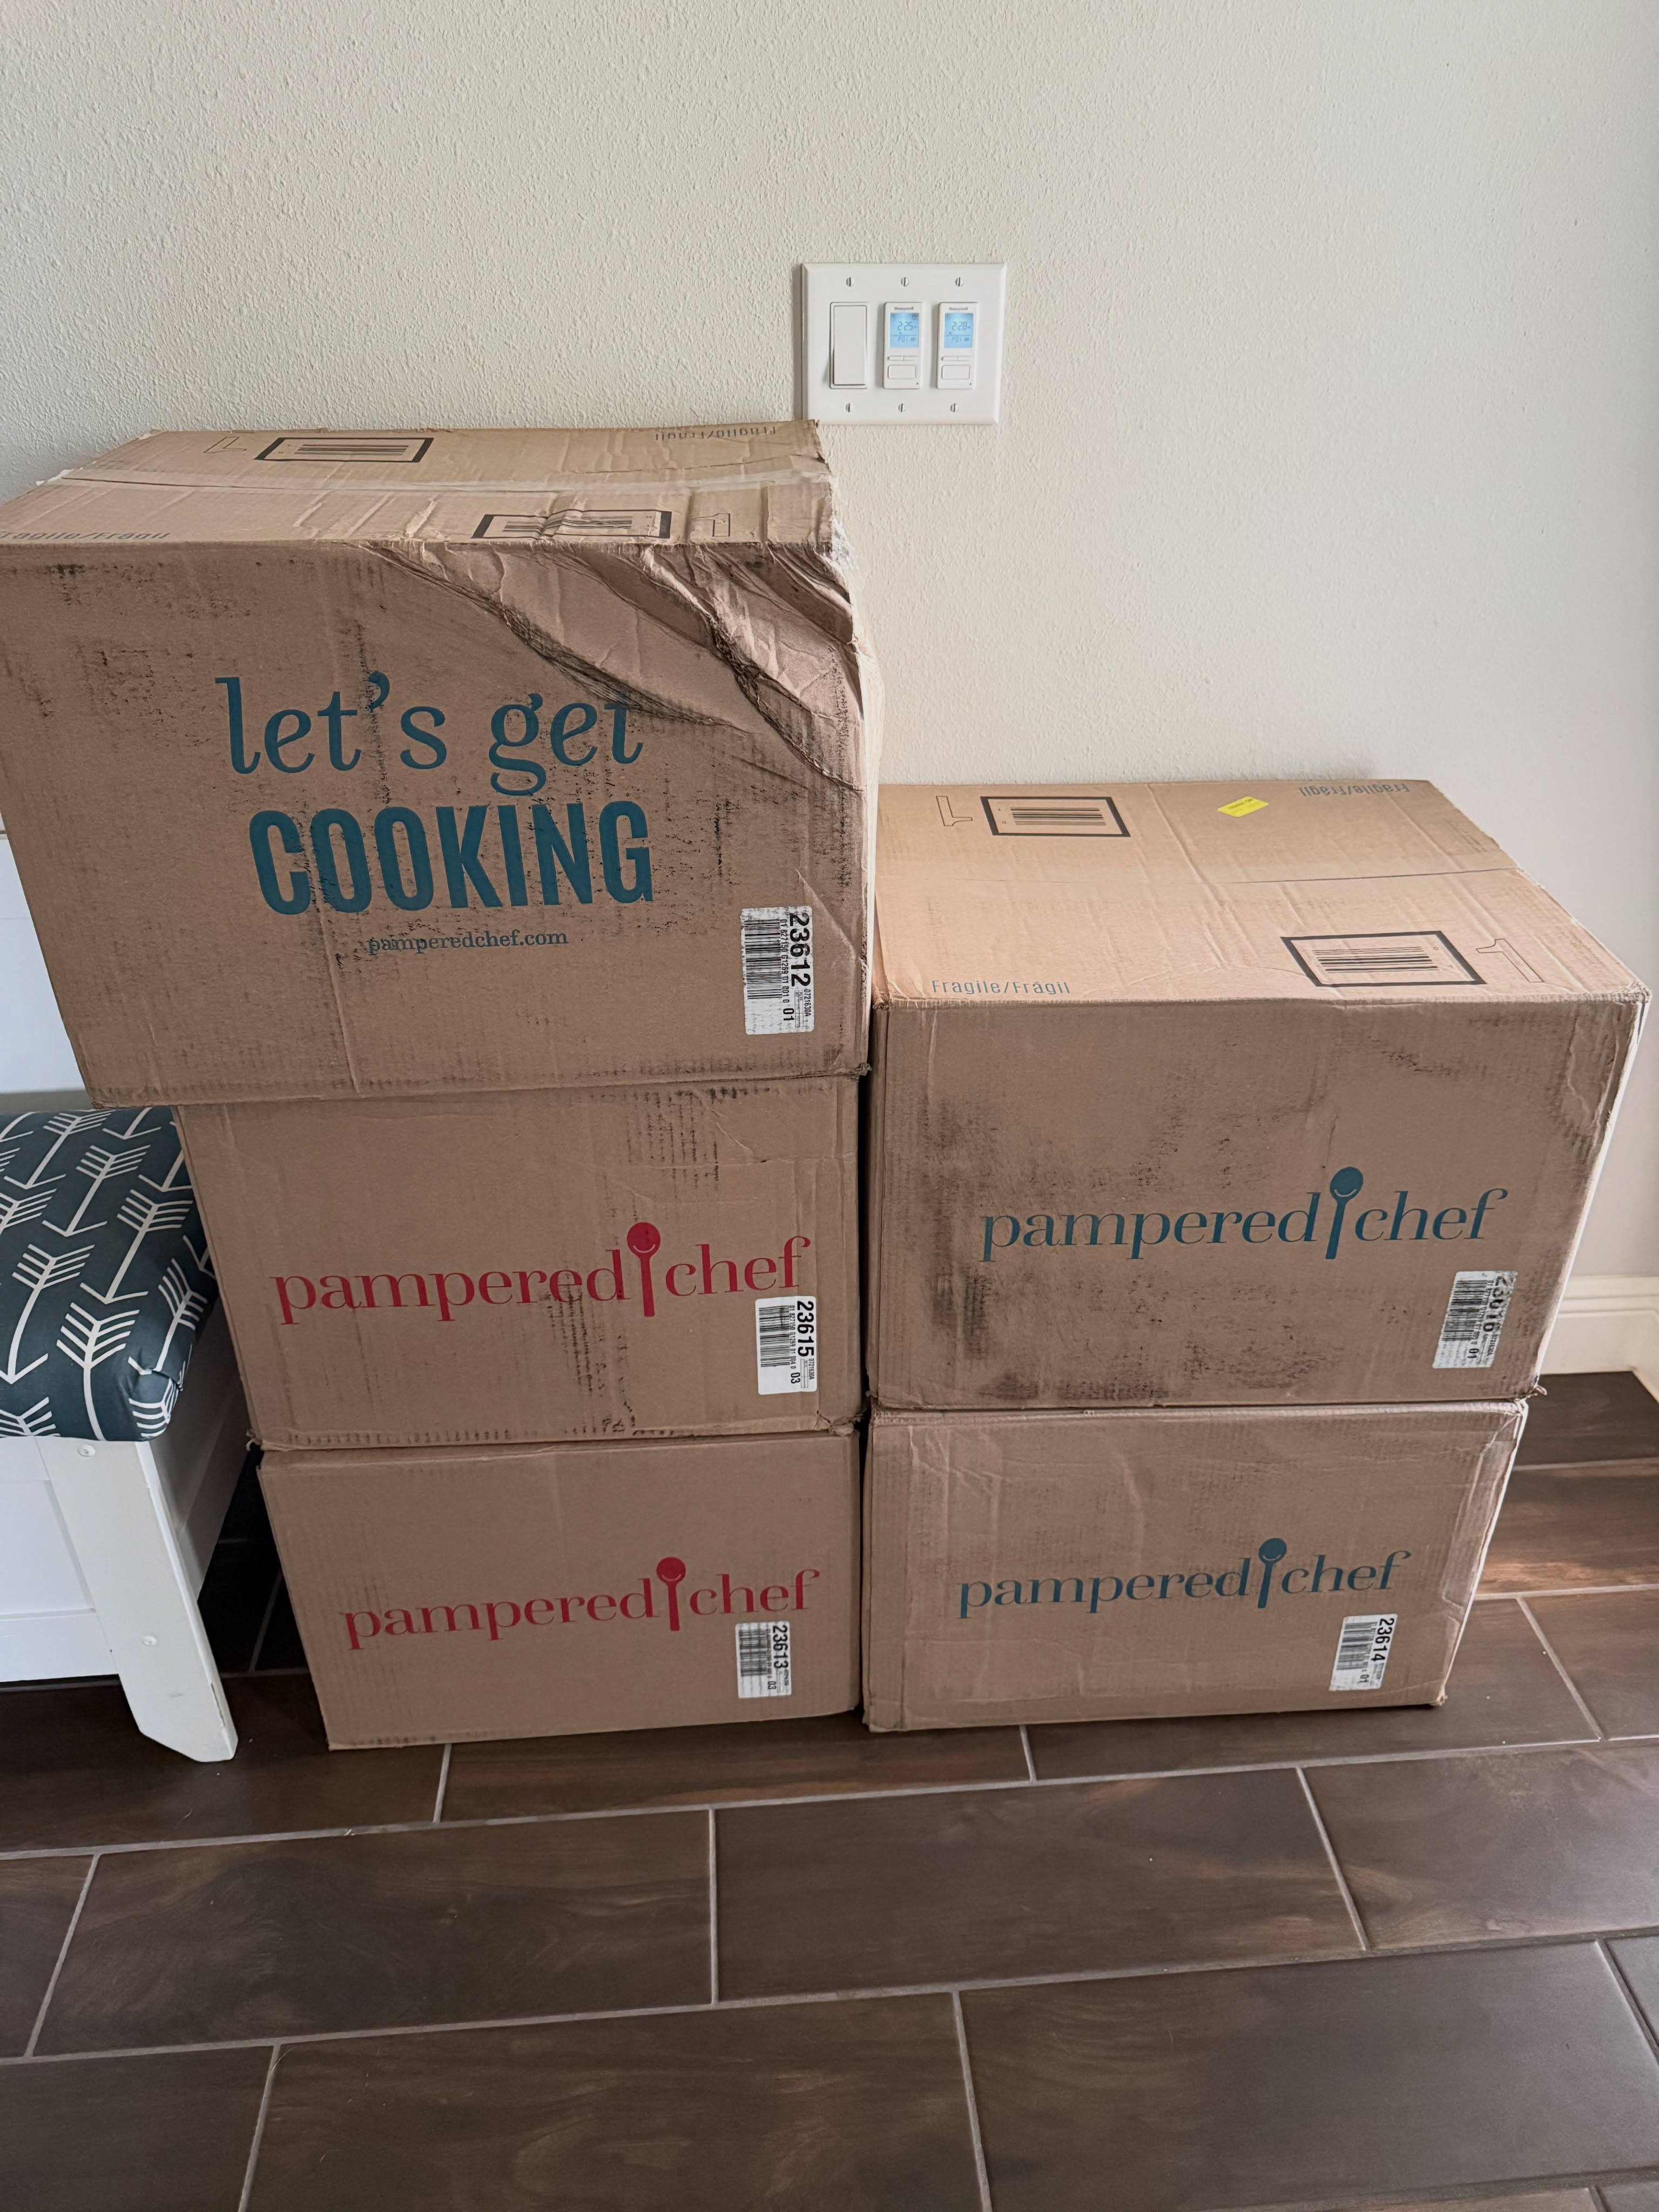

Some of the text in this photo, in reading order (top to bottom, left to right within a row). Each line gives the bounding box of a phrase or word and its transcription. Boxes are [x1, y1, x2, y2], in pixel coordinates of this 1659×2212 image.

[215, 671, 644, 797] let's get
[249, 801, 654, 915] COOKING
[367, 929, 569, 955] pamperedchef.com
[789, 913, 811, 987] 23612
[804, 989, 812, 1017] 0721630A
[932, 980, 1070, 995] Fragile/Frágil
[783, 1008, 795, 1021] 01
[978, 1188, 1508, 1263] pampered chef
[269, 1235, 811, 1325] pampered chef
[797, 1300, 814, 1357] 23615
[1467, 1348, 1480, 1359] 01
[791, 1372, 801, 1384] 03
[956, 1550, 1412, 1619] pampered chef
[339, 1568, 820, 1650] pampered chef
[772, 1625, 789, 1669] 23613
[1371, 1617, 1395, 1662] 23614
[767, 1681, 777, 1690] 03
